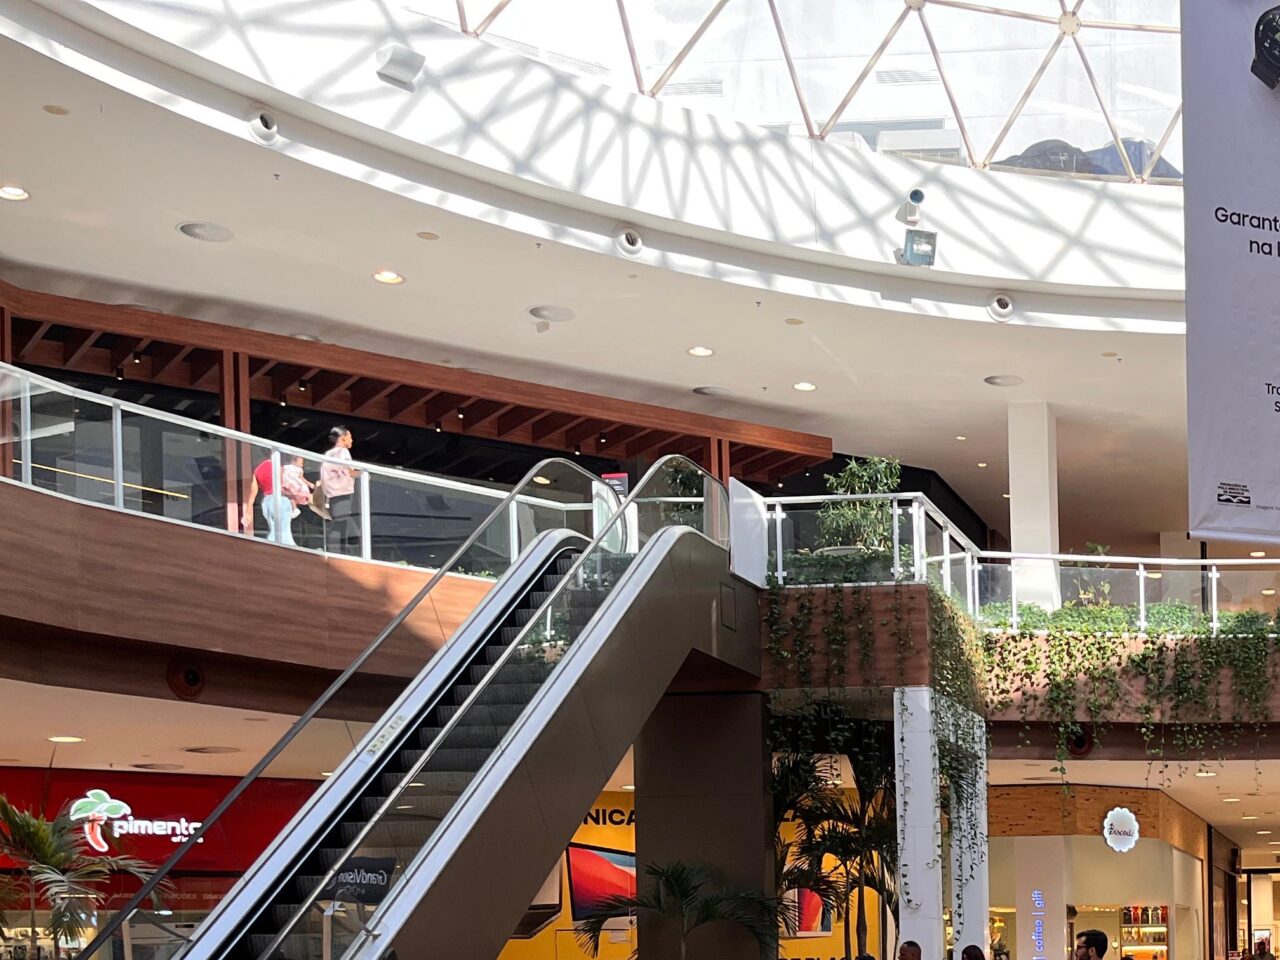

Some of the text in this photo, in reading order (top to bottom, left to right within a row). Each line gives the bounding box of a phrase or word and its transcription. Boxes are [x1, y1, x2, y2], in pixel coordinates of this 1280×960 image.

[1249, 238, 1272, 256] na
[1031, 889, 1045, 908] gift
[1031, 919, 1043, 952] coffee
